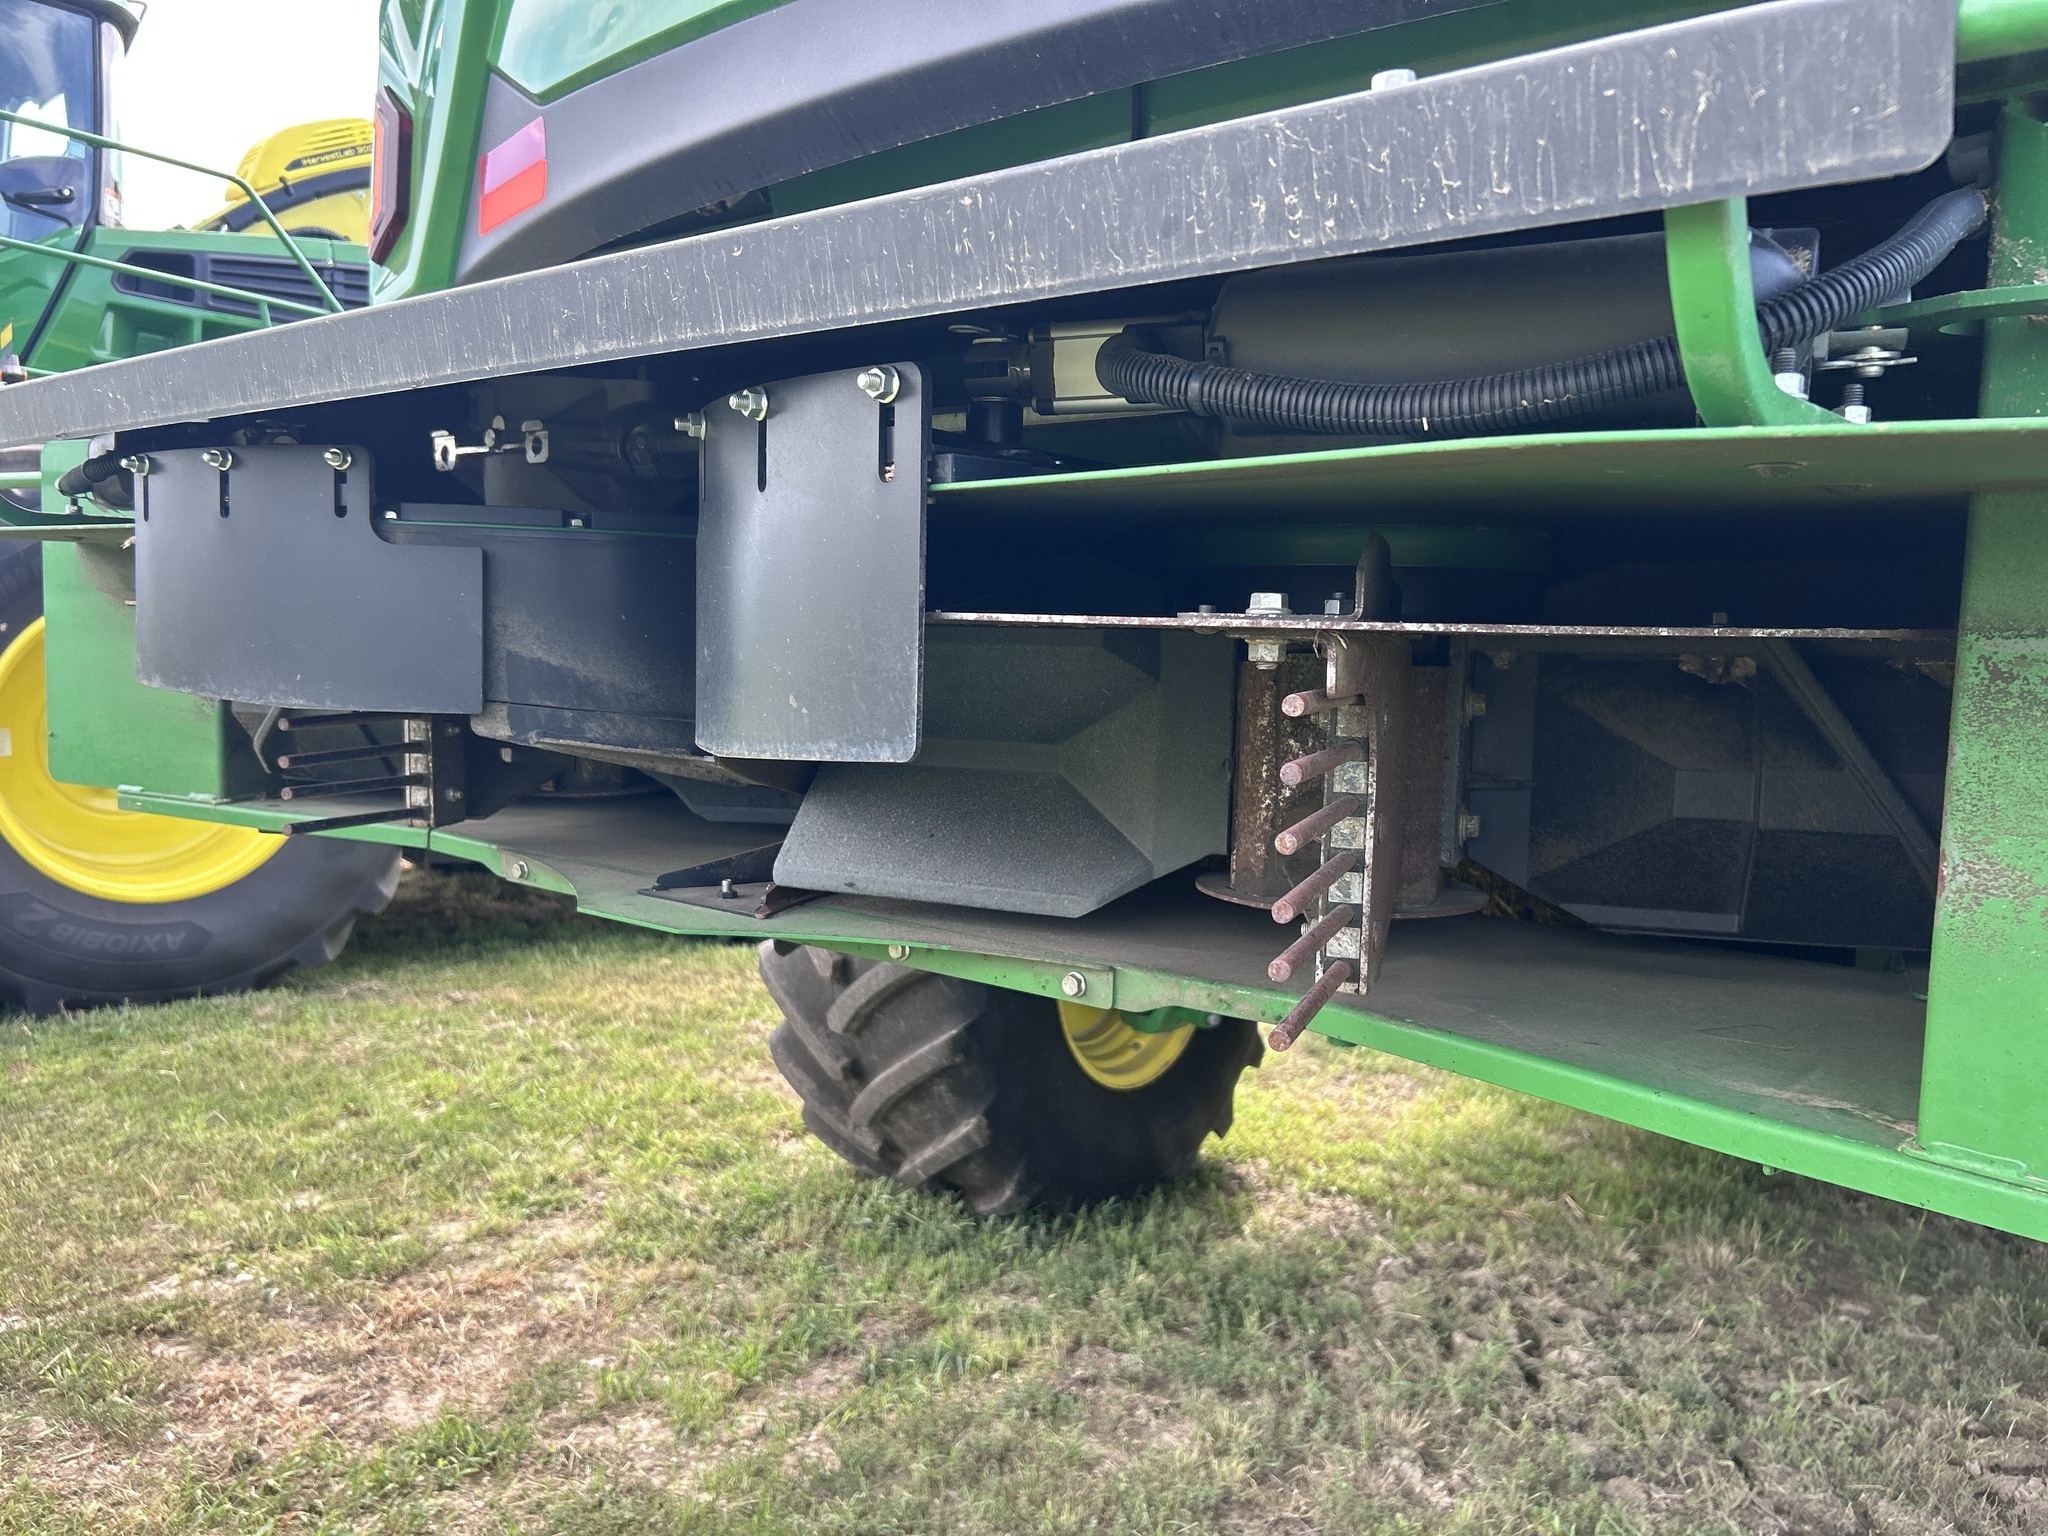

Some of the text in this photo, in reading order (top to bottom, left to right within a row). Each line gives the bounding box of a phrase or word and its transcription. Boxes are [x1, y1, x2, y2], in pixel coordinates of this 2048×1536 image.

[301, 147, 356, 167] HarvestLab
[13, 899, 187, 954] AXIOBIB 2
